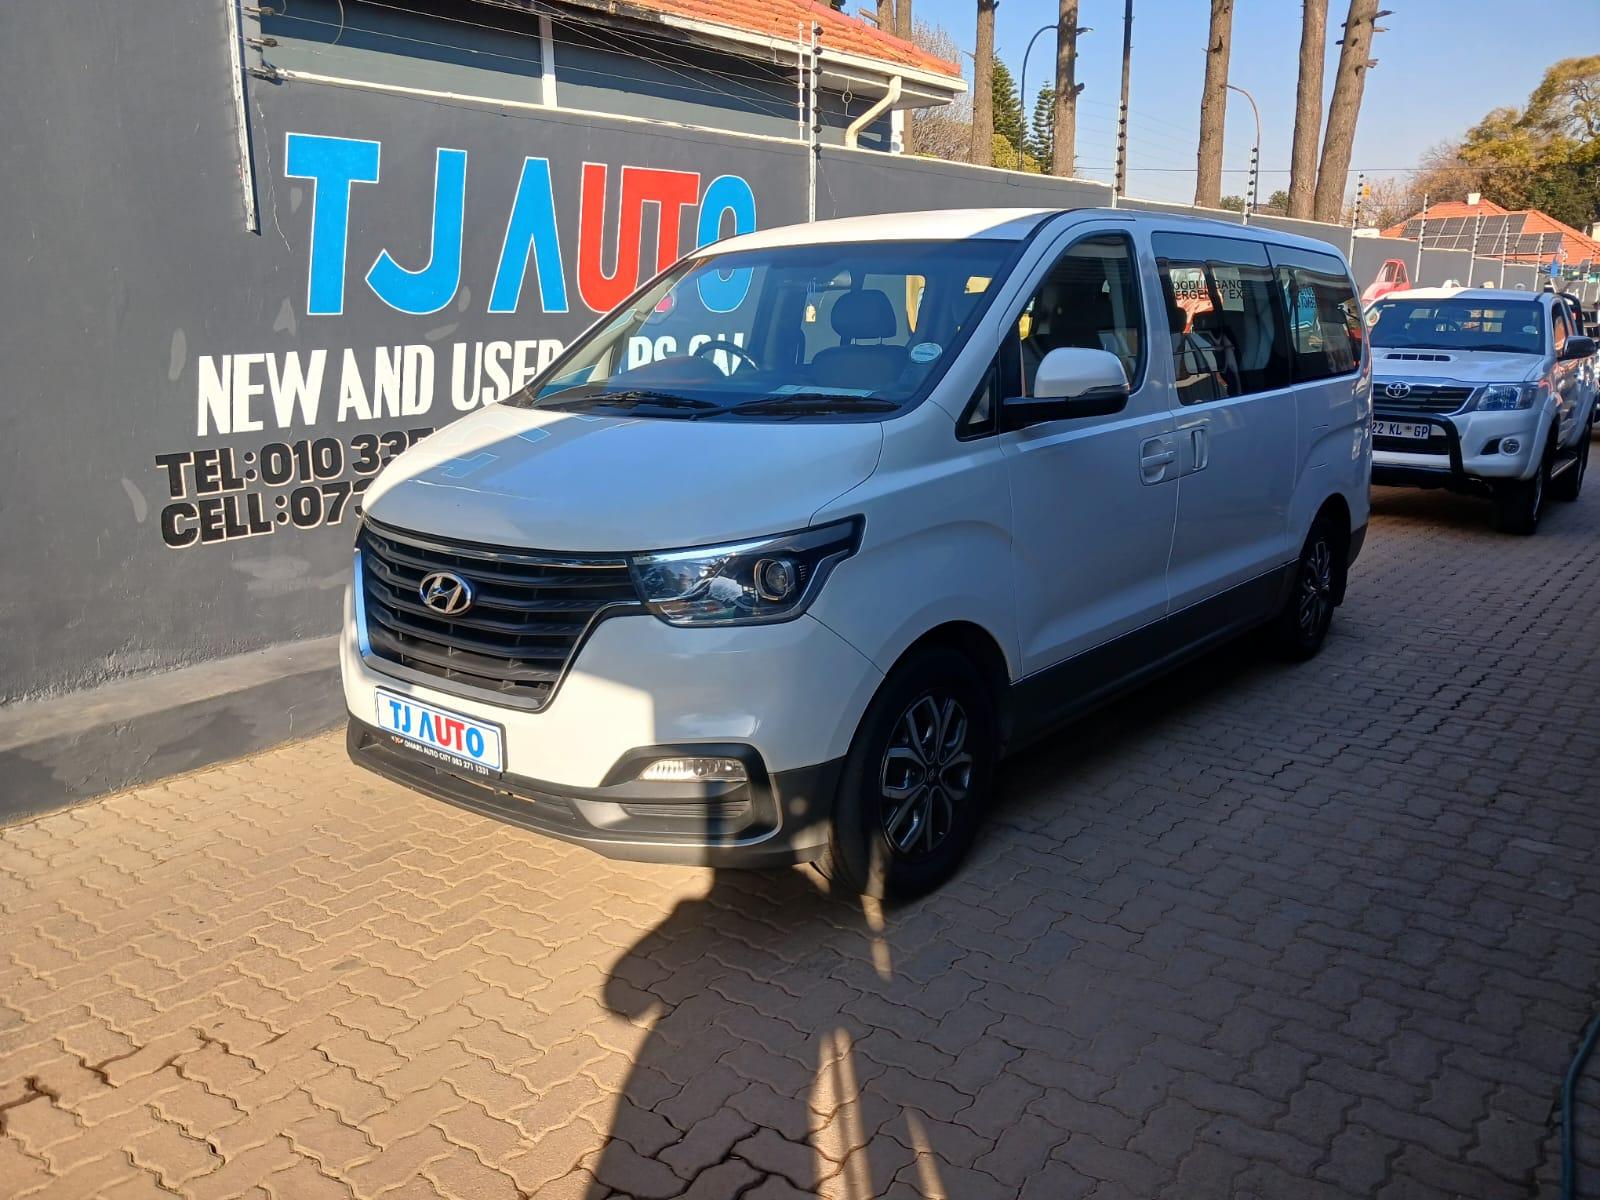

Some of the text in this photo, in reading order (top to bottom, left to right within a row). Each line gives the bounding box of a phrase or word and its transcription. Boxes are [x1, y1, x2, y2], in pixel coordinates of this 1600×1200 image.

[284, 131, 757, 316] TJ AUTO
[197, 349, 328, 437] NEW
[337, 343, 435, 423] AND
[1389, 423, 1402, 436] KL
[1414, 425, 1429, 438] GP
[155, 437, 344, 500] TEL:010
[389, 700, 485, 759] TJ AUTO
[424, 748, 439, 758] AUTO
[440, 753, 451, 763] CITY
